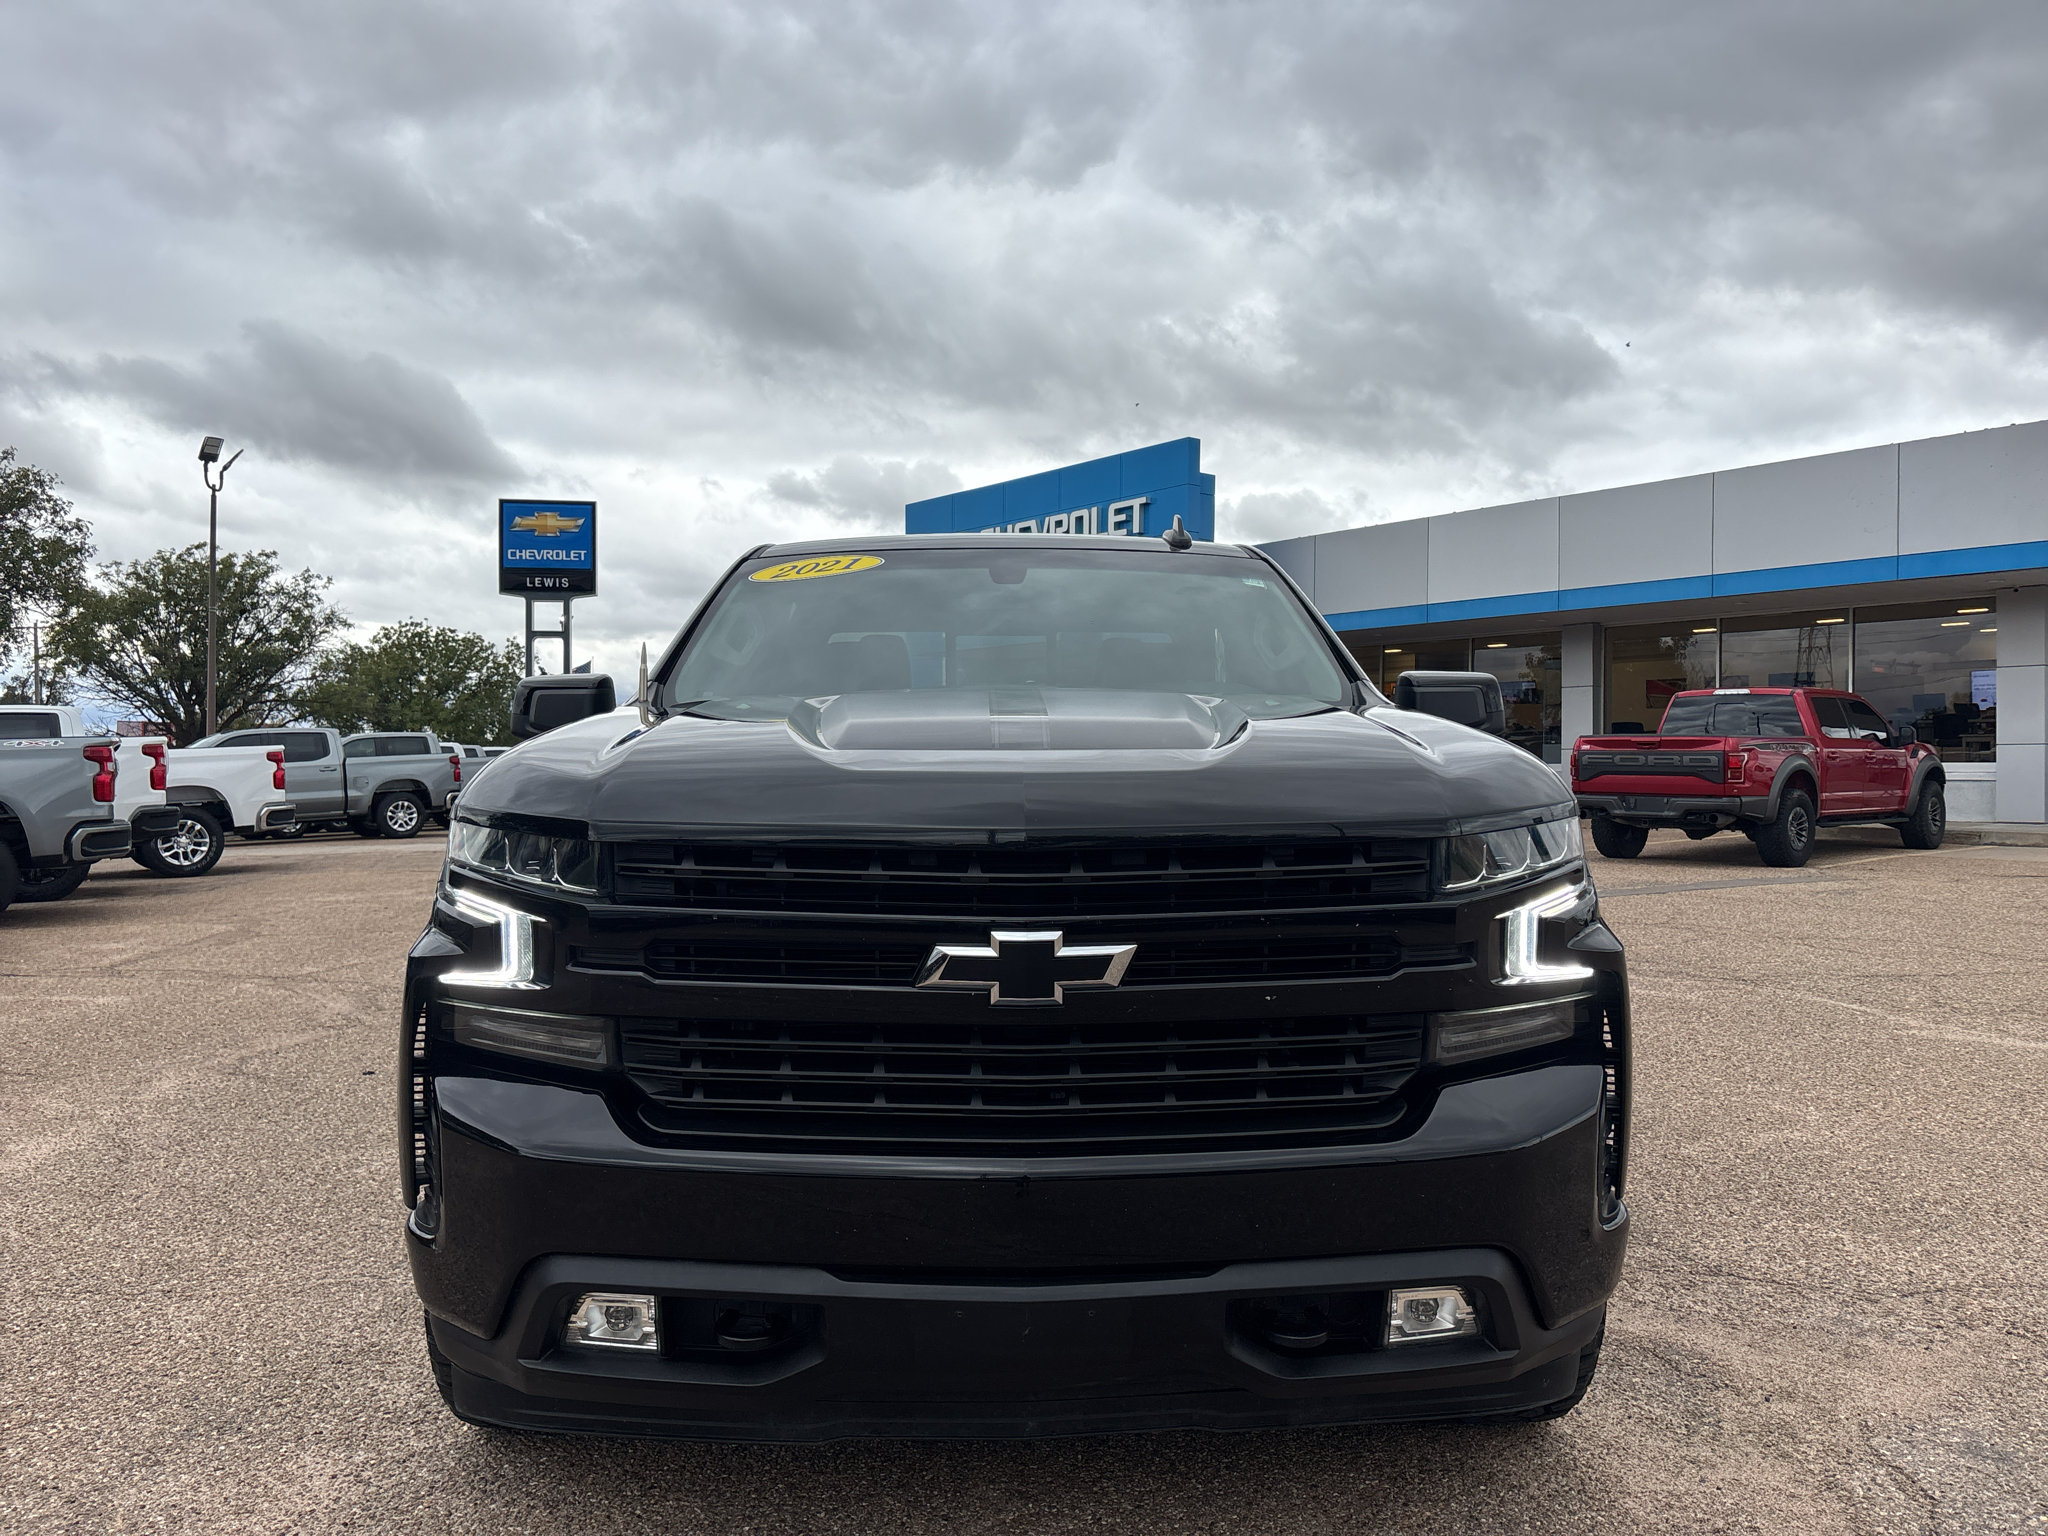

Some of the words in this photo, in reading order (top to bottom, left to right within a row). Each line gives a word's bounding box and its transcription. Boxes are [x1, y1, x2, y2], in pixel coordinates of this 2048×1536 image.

[507, 549, 587, 561] CHEVROLET
[769, 557, 861, 579] 2021
[526, 577, 569, 588] LEWIS
[1581, 755, 1719, 766] FORD
